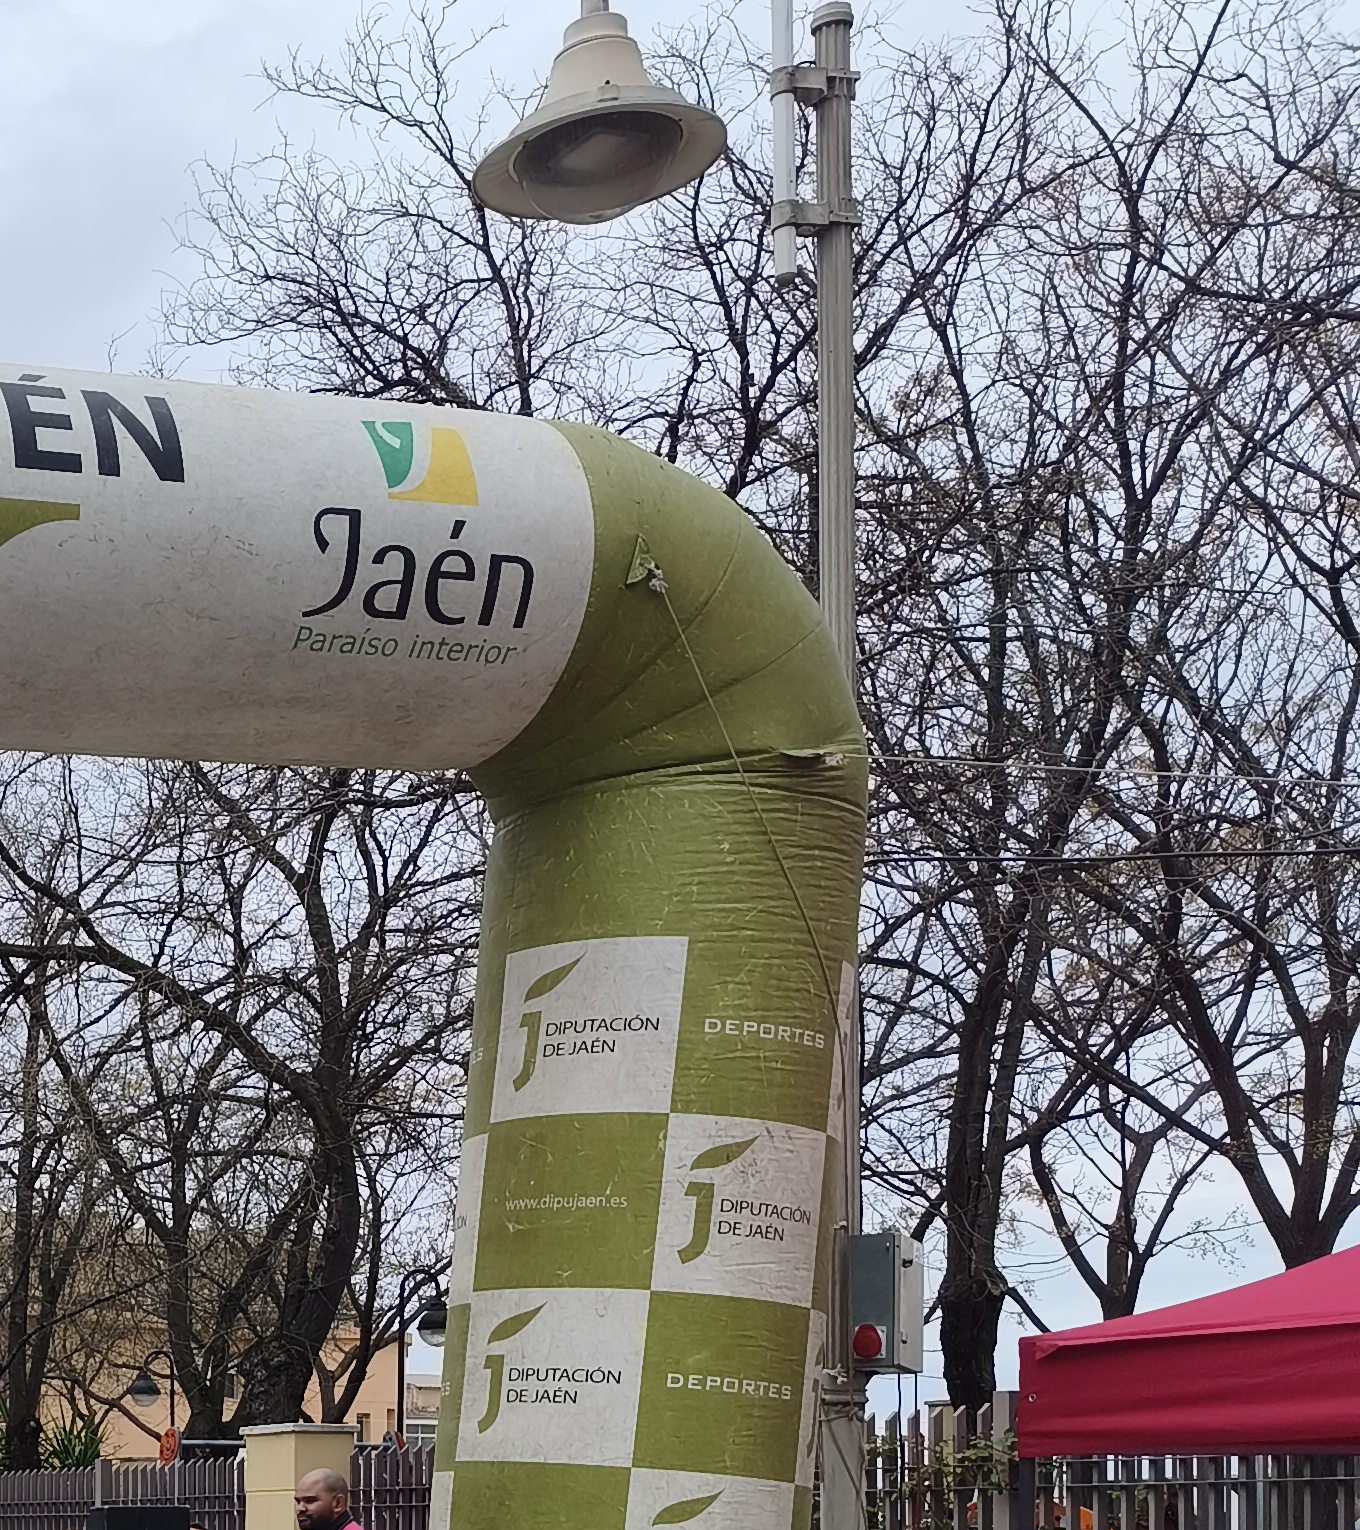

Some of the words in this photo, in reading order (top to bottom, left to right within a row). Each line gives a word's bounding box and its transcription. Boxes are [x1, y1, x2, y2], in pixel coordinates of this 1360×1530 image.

[302, 507, 534, 628] Jaén
[292, 626, 398, 657] Paraíso
[409, 635, 517, 665] interior
[546, 1015, 659, 1036] DIPUTACIÓN
[705, 1019, 824, 1048] DEPORTES
[543, 1043, 565, 1057] DE
[569, 1038, 615, 1055] JAÉN
[506, 1192, 627, 1211] www.dipujaen.es
[721, 1199, 810, 1224] DIPUTACIÓN
[718, 1221, 742, 1236] DE
[745, 1223, 784, 1241] JAÉN
[509, 1367, 621, 1384] DIPUTACIÓN
[667, 1373, 791, 1399] DEPORTES
[507, 1389, 527, 1402] DE
[531, 1387, 577, 1403] JAÉN
